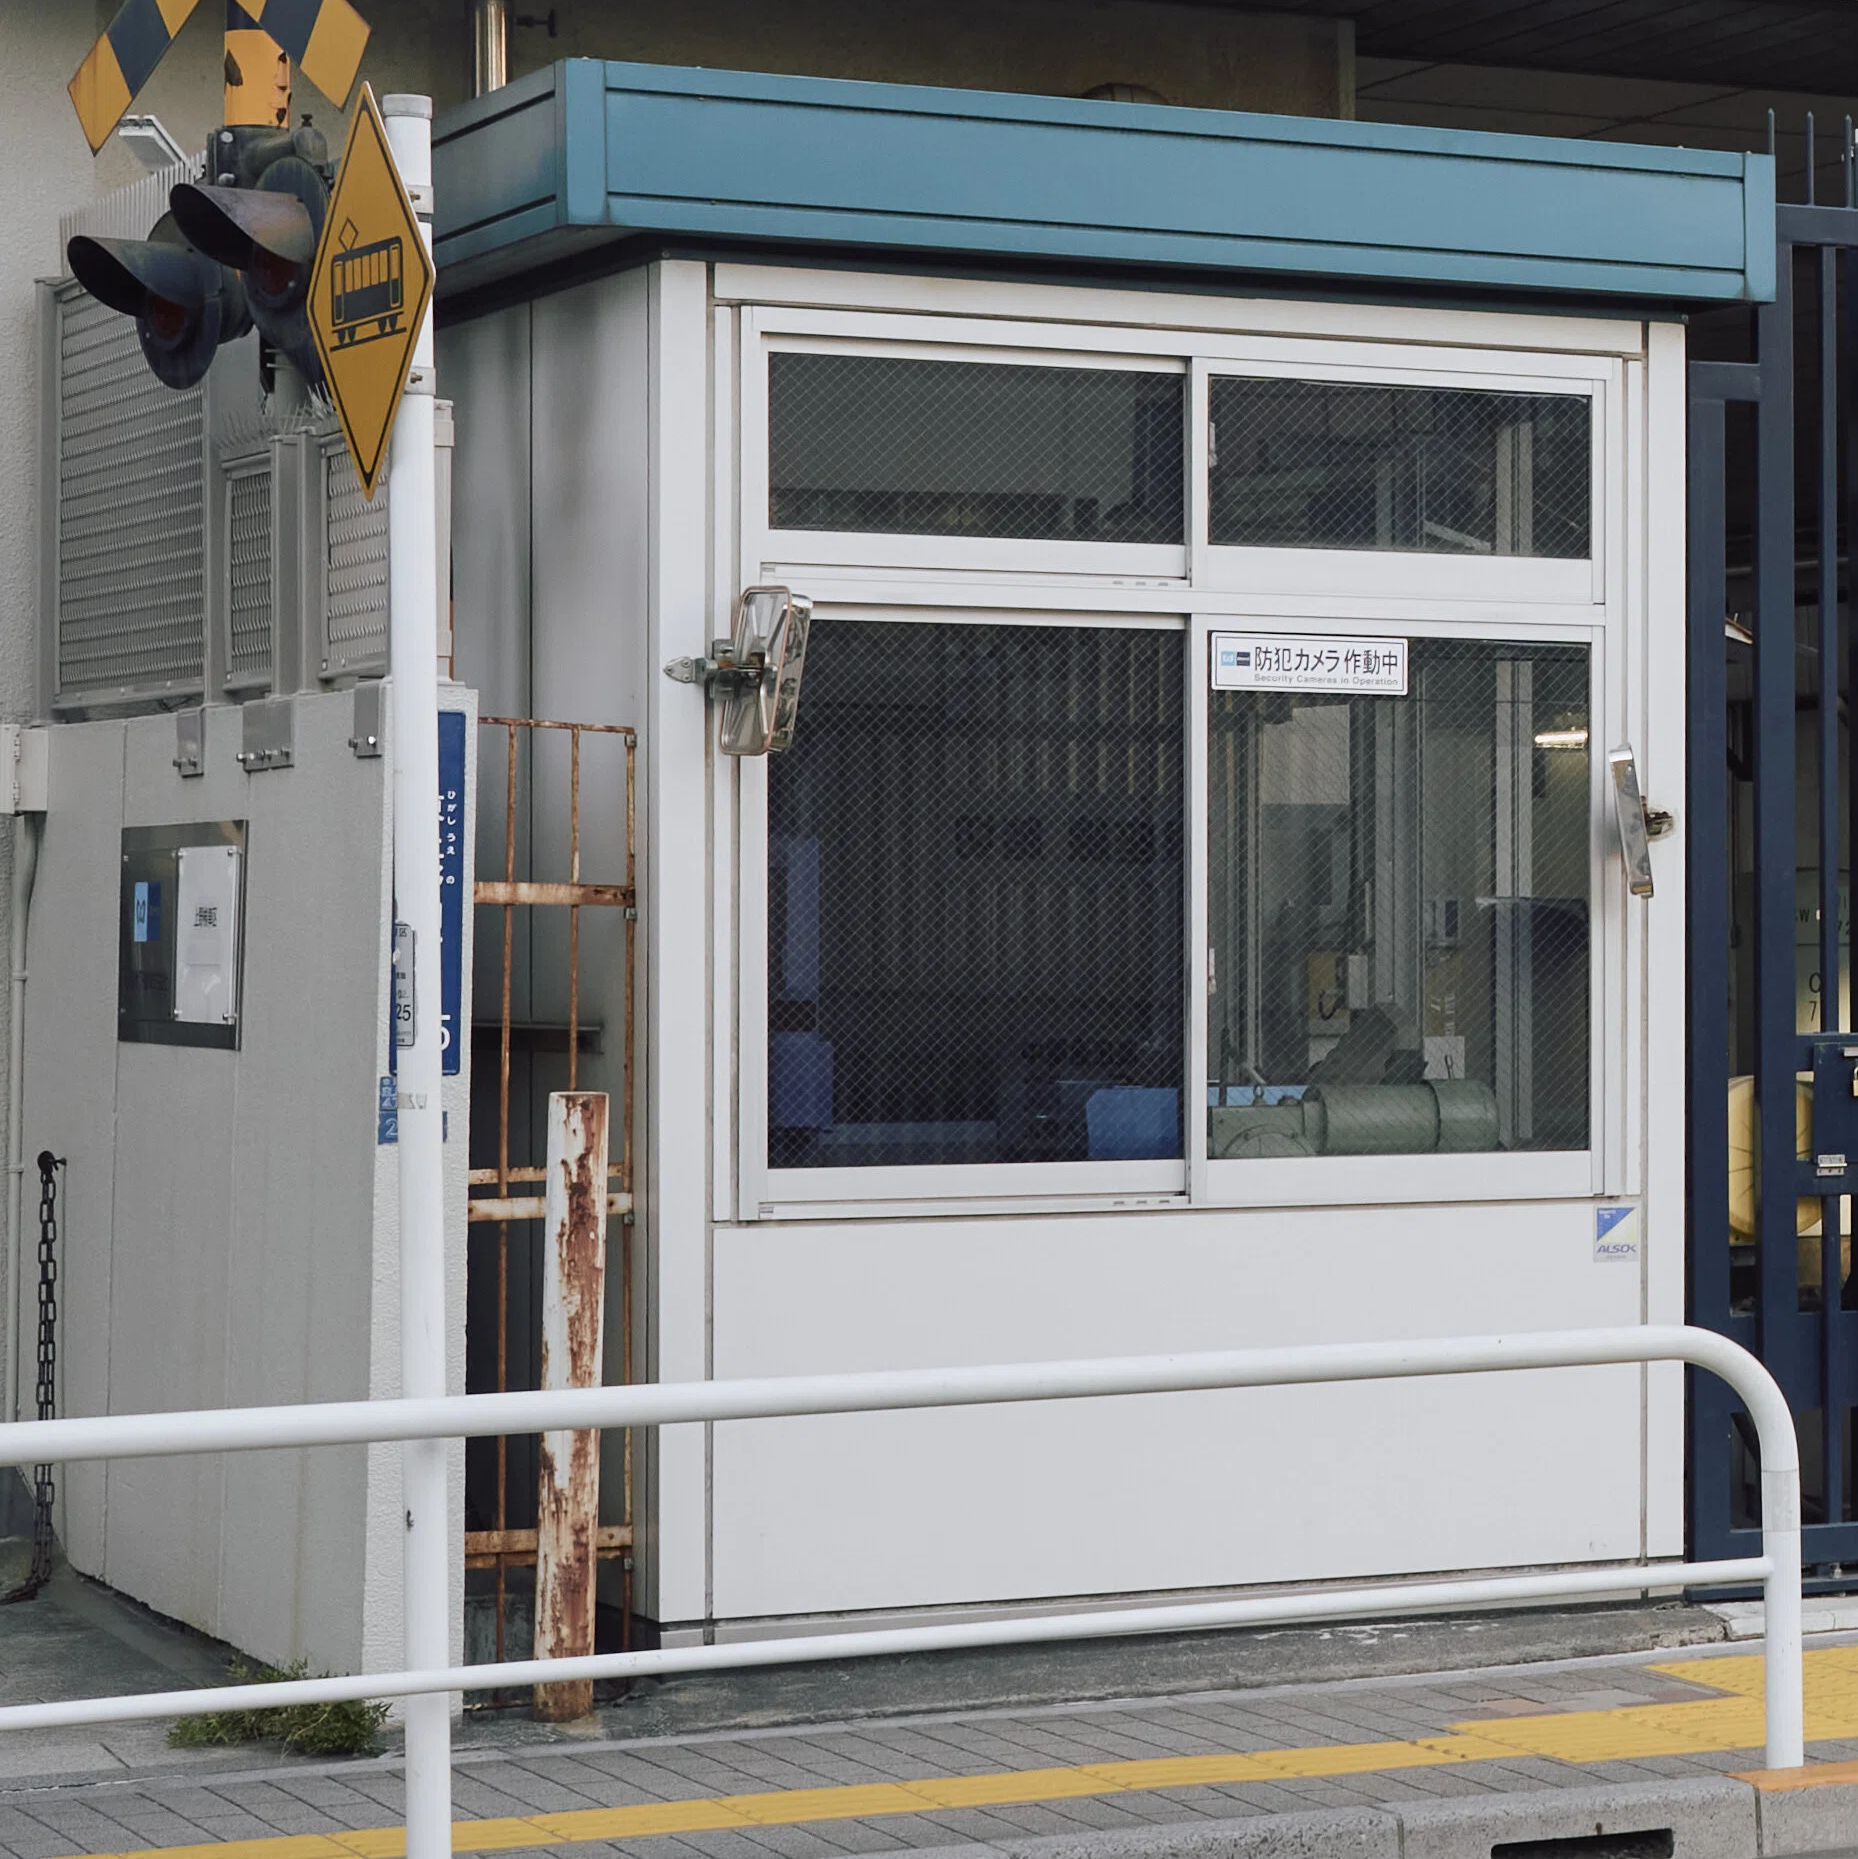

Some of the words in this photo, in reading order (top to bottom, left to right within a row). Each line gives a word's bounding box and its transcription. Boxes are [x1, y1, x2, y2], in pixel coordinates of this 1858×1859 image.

[1254, 646, 1398, 675] 防犯カメラ作動中
[1254, 674, 1293, 684] Security
[1297, 675, 1338, 684] Cameras
[1341, 676, 1349, 684] in
[1352, 676, 1398, 686] Operation
[1597, 1244, 1636, 1254] ALSOK
